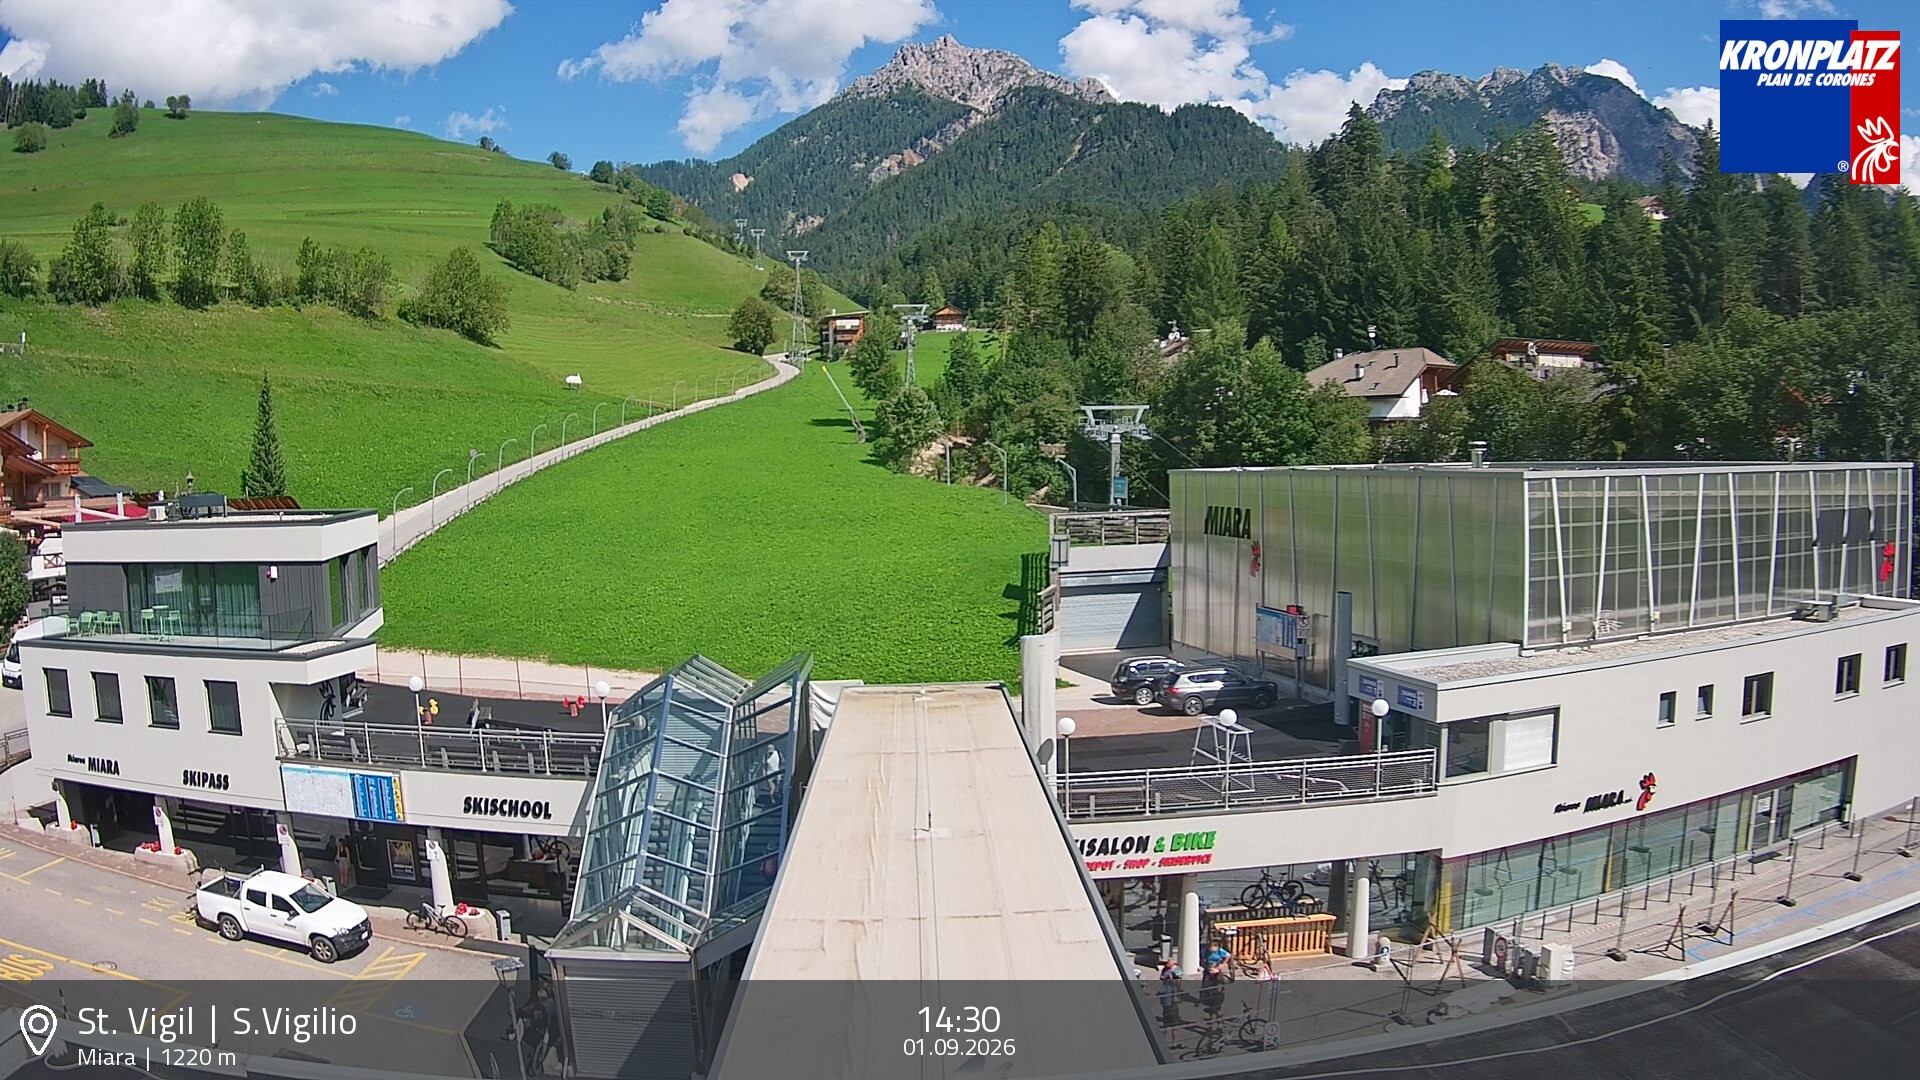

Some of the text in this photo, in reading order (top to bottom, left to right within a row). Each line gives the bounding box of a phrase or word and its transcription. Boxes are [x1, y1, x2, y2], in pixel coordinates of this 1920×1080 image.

[1204, 506, 1251, 539] MIARA
[88, 756, 120, 776] MIARA
[182, 769, 230, 791] SKIPASS
[463, 796, 552, 820] SKISCHOOL
[1153, 836, 1166, 853] &
[1169, 831, 1217, 852] BIKE
